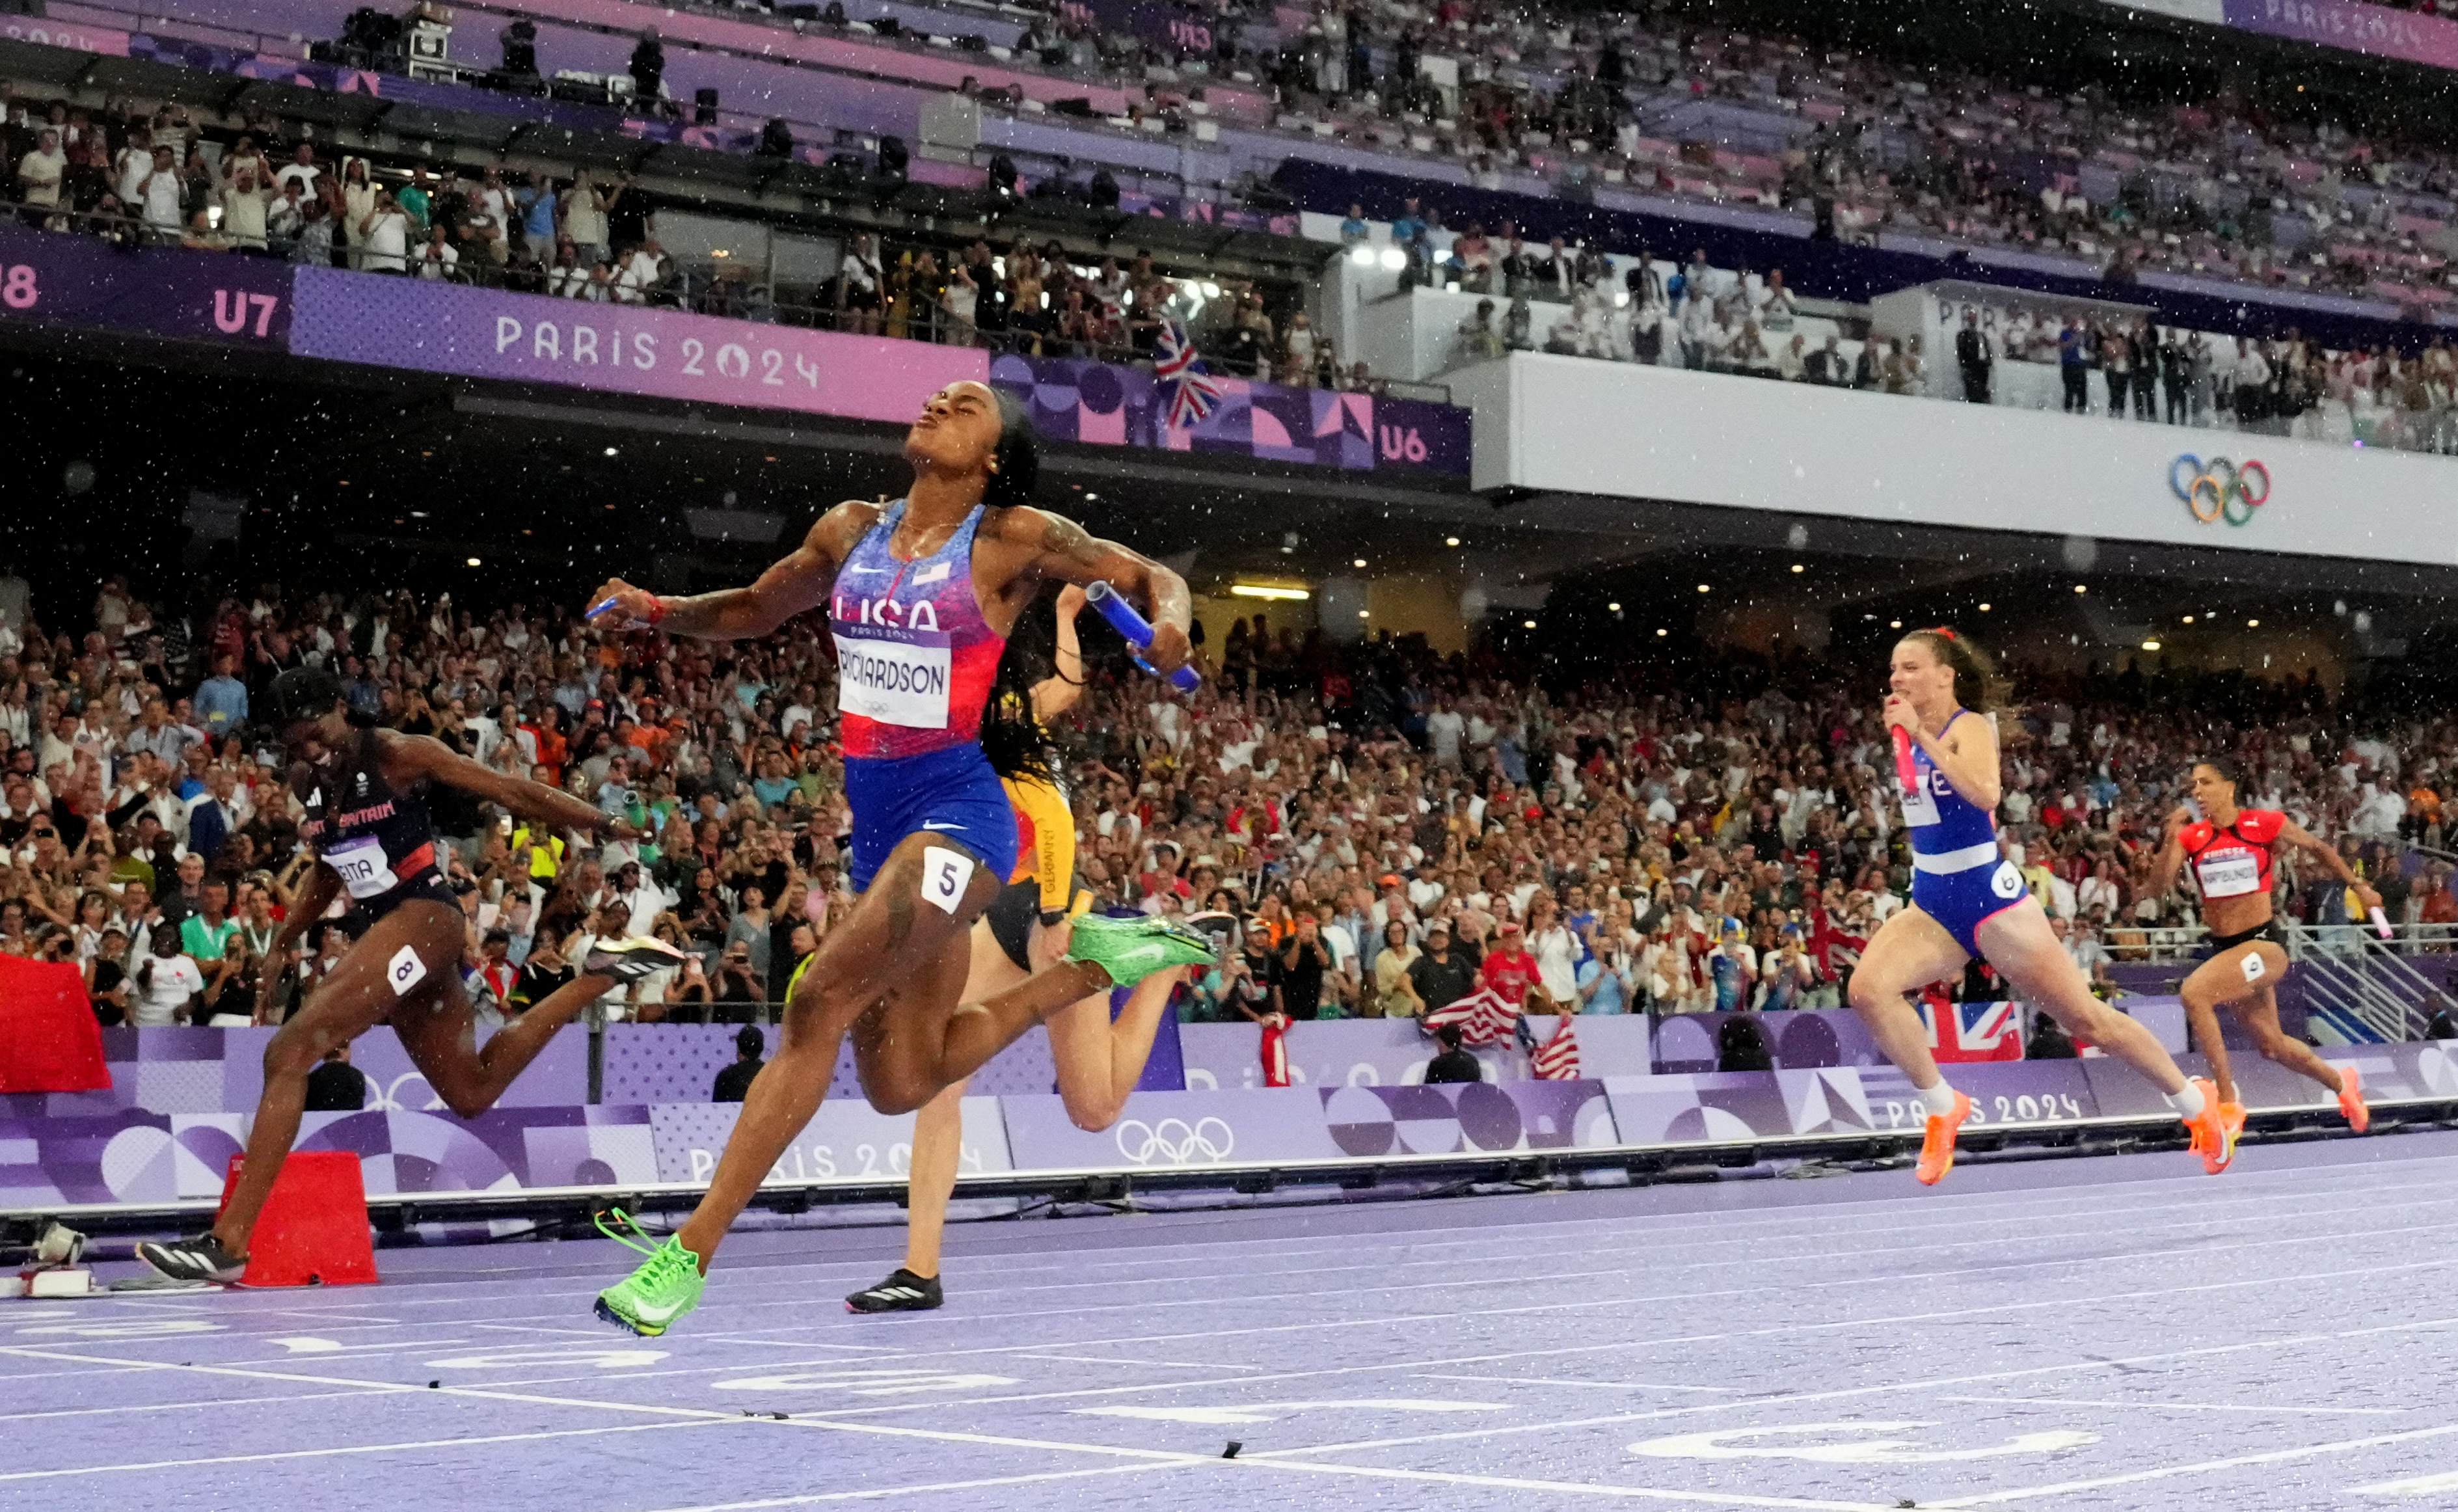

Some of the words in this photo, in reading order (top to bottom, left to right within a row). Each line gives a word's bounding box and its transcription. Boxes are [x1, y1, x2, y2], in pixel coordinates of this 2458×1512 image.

[0, 263, 38, 308] 8
[215, 289, 278, 337] U7
[682, 338, 819, 388] 2024
[1381, 424, 1427, 462] U6
[338, 859, 374, 883] EITA
[939, 861, 957, 897] 5
[396, 960, 413, 981] 8
[1995, 1092, 2083, 1123] 2024
[856, 1142, 982, 1176] 204
